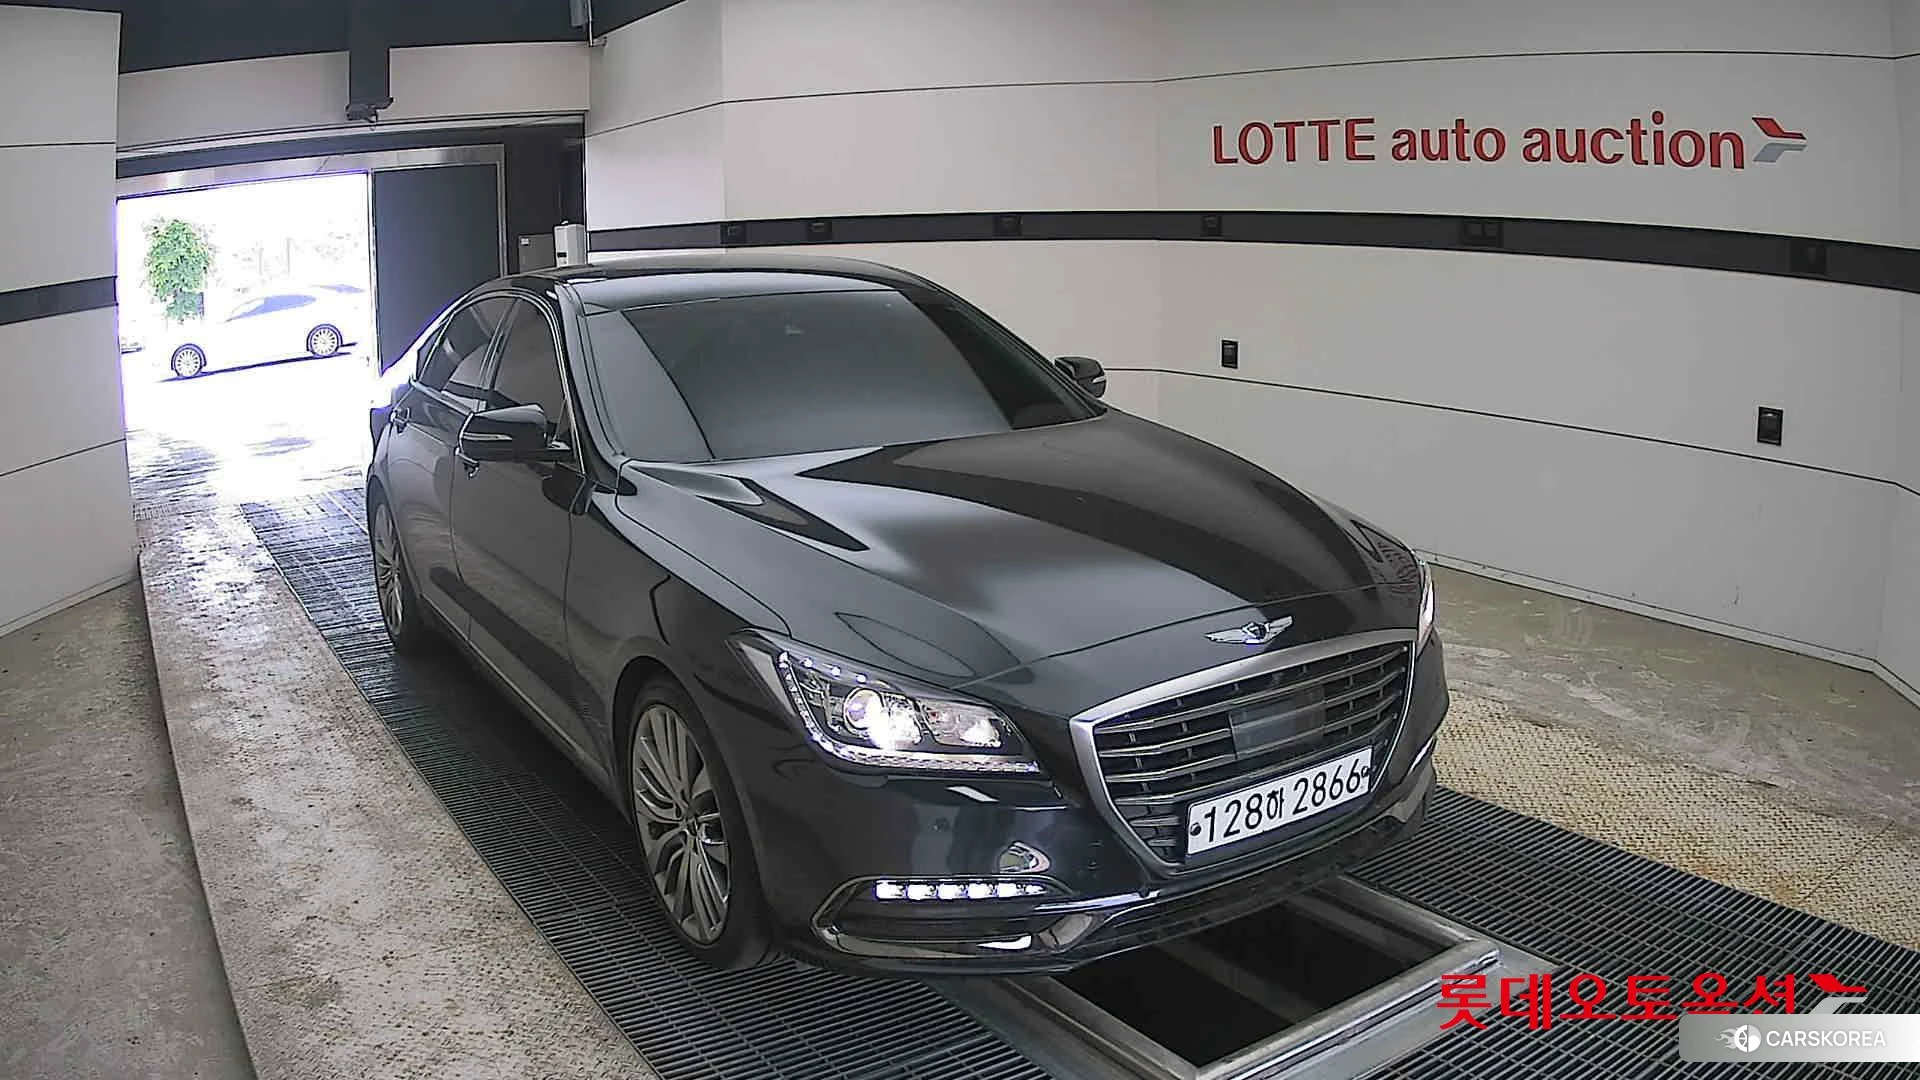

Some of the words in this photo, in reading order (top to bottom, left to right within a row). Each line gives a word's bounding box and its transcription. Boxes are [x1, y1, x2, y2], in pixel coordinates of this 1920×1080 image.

[1212, 117, 1376, 164] LOTTE
[1391, 119, 1507, 162] auto
[1522, 111, 1746, 169] auction
[1204, 787, 1284, 843] 128하
[1292, 759, 1361, 816] 2866
